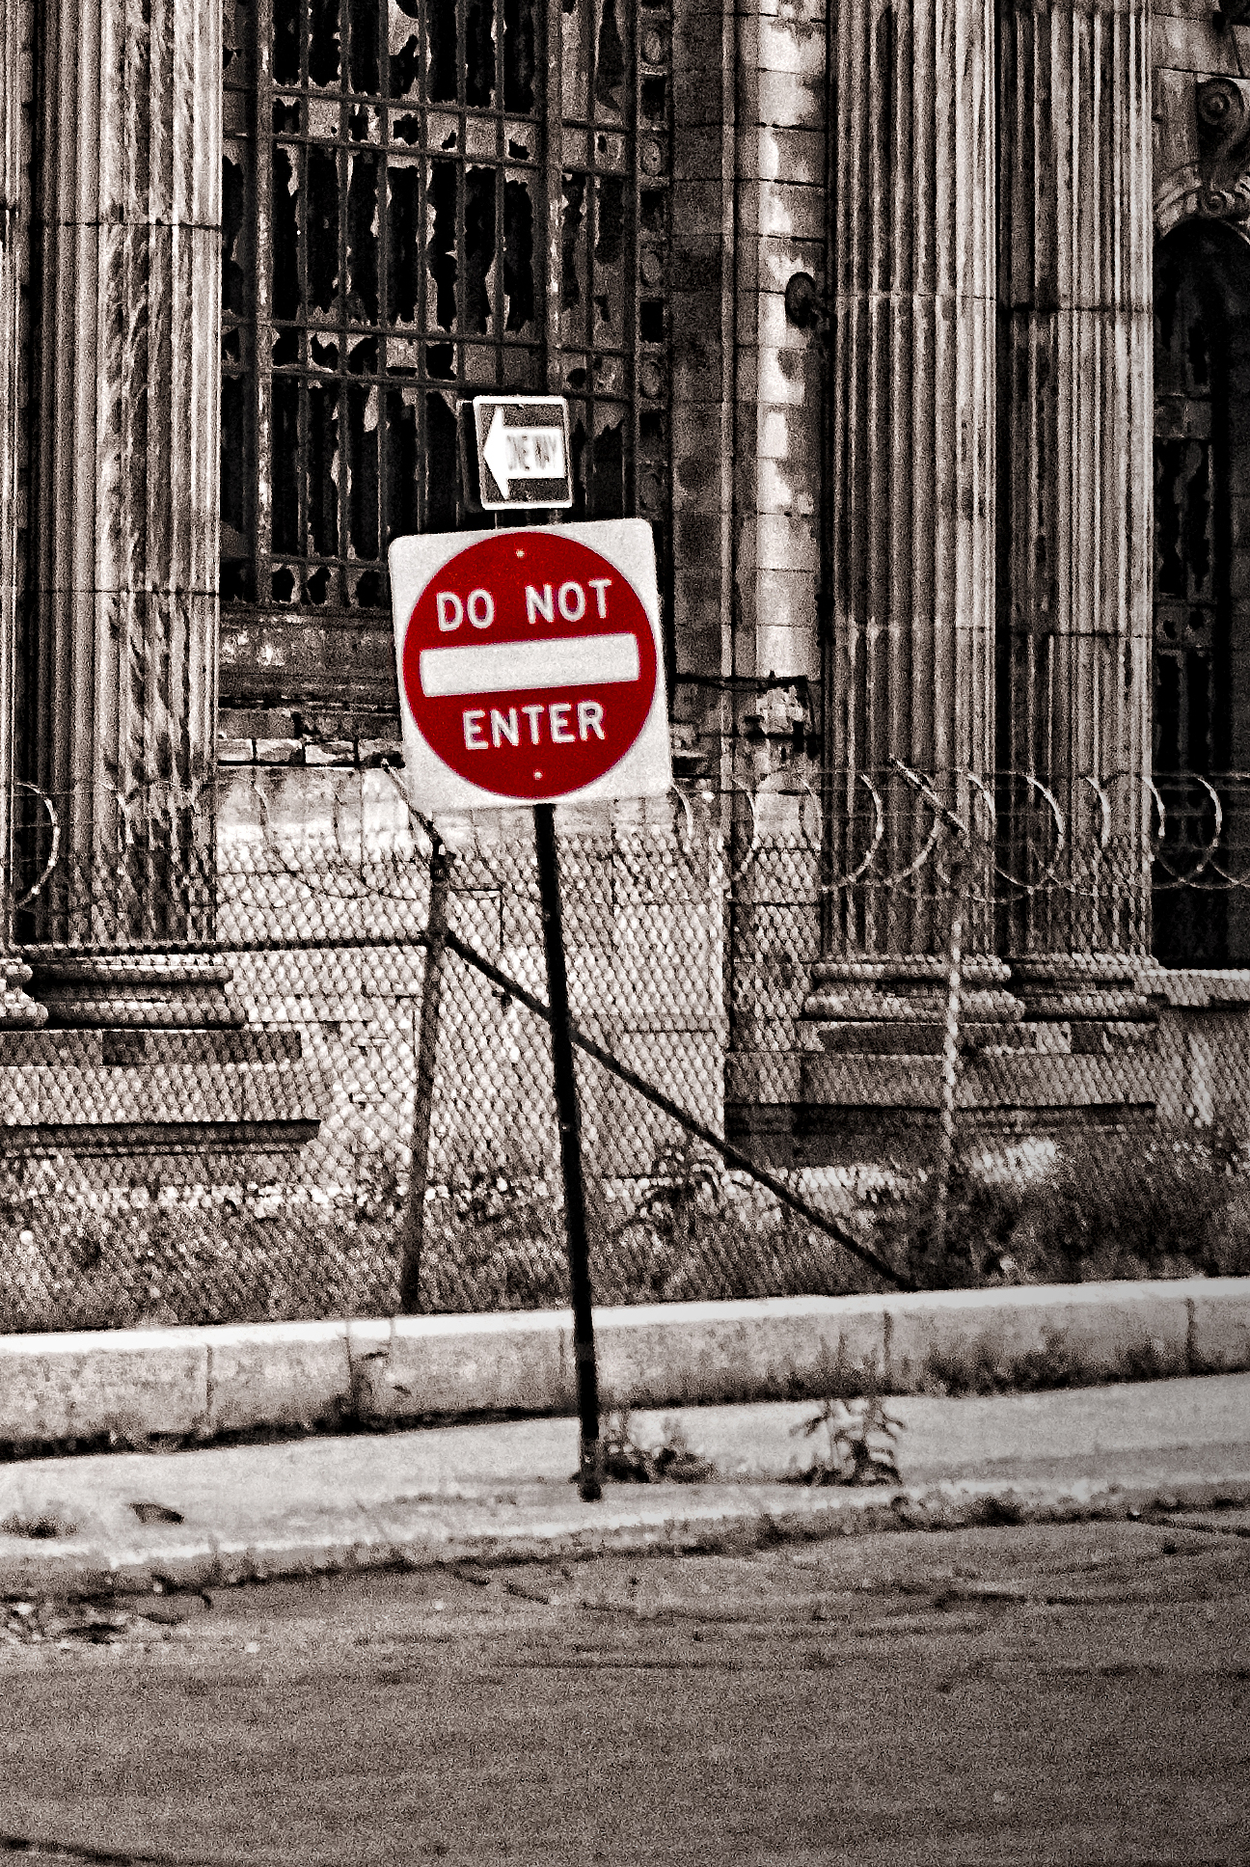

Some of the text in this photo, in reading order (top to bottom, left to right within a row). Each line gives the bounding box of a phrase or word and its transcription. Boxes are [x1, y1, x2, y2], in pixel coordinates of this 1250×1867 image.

[436, 578, 613, 632] DO NOT
[462, 699, 607, 751] ENTER
